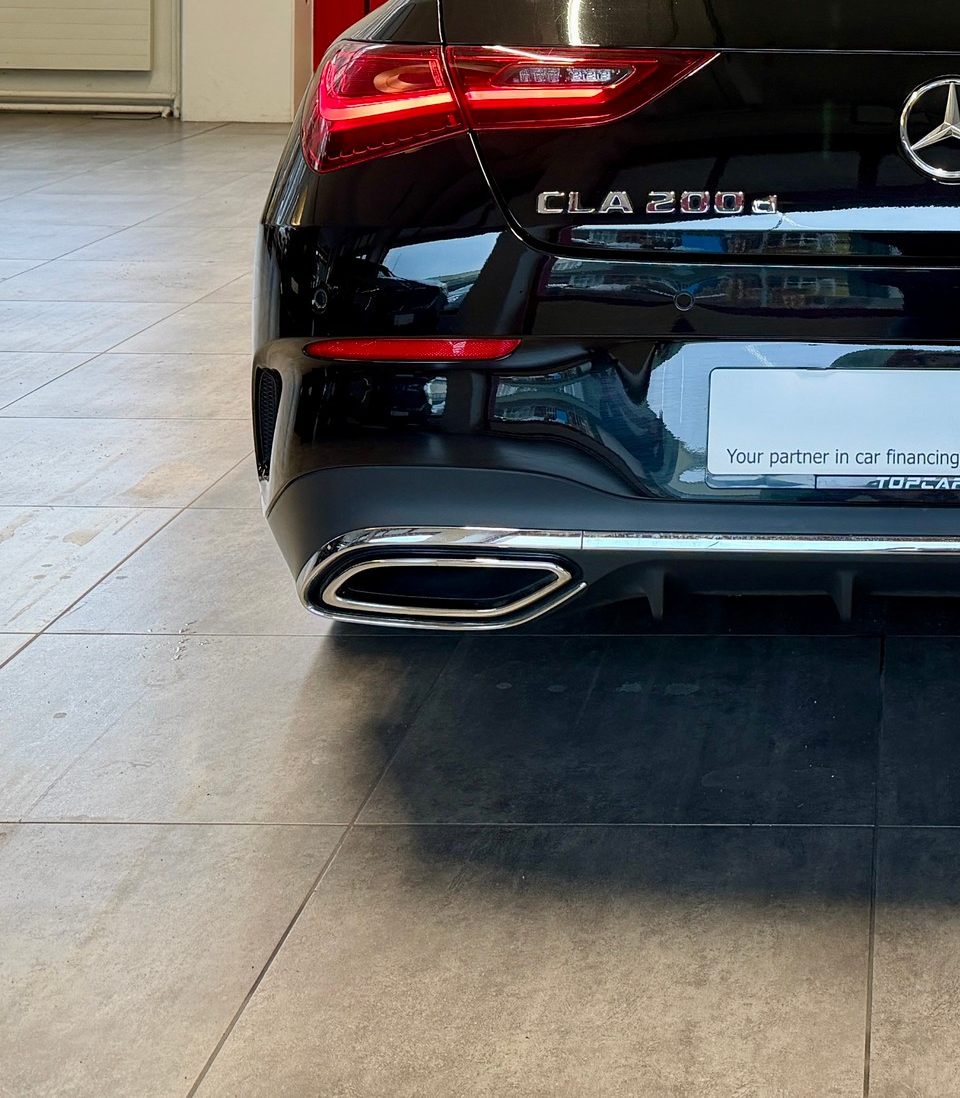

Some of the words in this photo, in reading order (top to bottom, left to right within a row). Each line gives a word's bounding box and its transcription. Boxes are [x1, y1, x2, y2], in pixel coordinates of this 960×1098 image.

[537, 191, 634, 213] CLA
[727, 449, 763, 465] Your
[770, 450, 829, 467] partner
[835, 449, 850, 465] in
[855, 453, 881, 465] car
